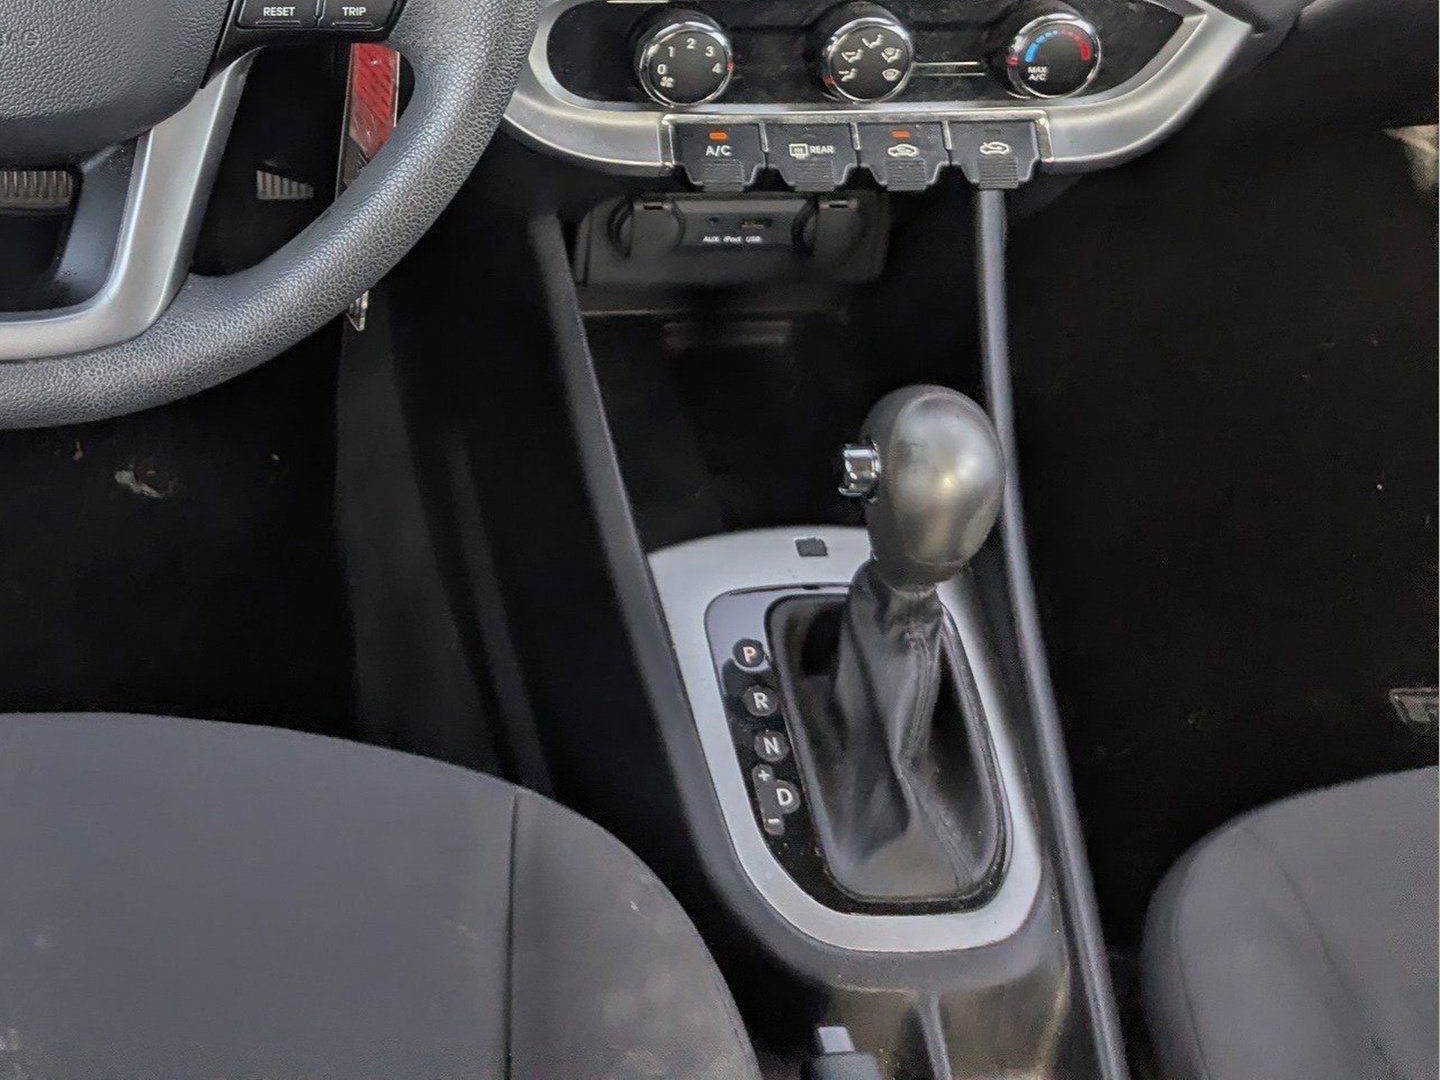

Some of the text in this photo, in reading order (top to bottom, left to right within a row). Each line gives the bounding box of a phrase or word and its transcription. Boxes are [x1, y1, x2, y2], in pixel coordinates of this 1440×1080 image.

[263, 6, 296, 16] RESET
[342, 7, 367, 16] TRIP
[687, 38, 697, 49] 2
[668, 46, 675, 57] 1
[705, 46, 714, 57] 3
[657, 64, 667, 75] 0
[712, 64, 722, 73] 4
[1028, 66, 1047, 74] MAX
[1028, 73, 1047, 81] A/C
[706, 145, 732, 157] A/C
[809, 145, 834, 154] REAR
[742, 646, 756, 663] P
[753, 692, 769, 710] R
[764, 736, 780, 755] N
[776, 788, 792, 806] D
